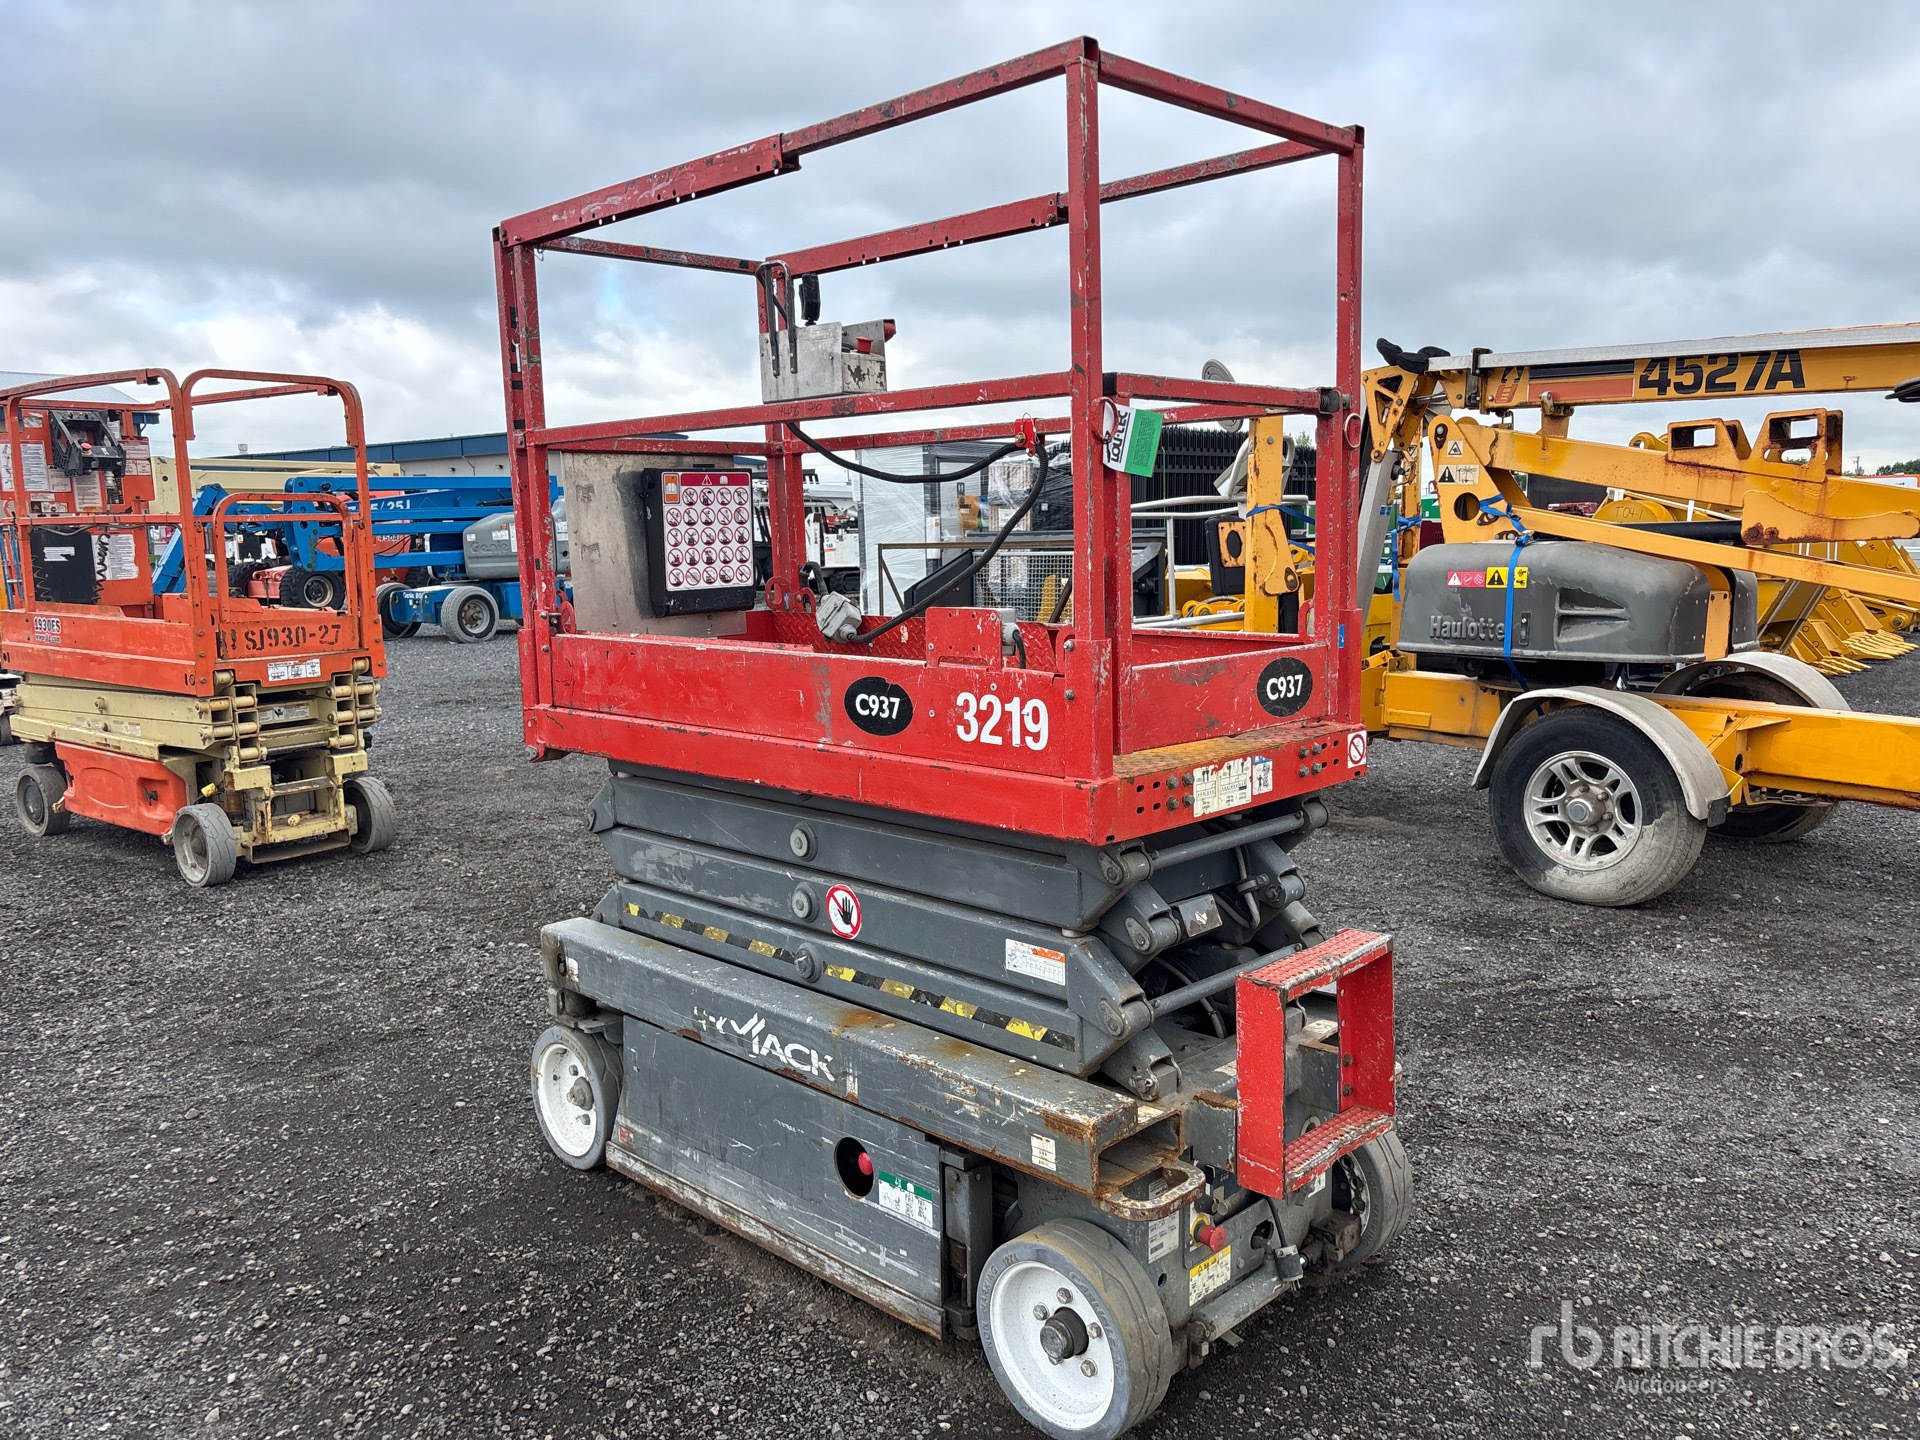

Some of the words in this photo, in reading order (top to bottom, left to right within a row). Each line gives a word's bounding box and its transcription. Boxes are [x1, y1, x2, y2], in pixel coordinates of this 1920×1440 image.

[1638, 351, 1806, 396] 4527A
[1429, 615, 1505, 641] Haulotte
[1266, 673, 1303, 700] C937
[855, 693, 900, 720] C937
[956, 692, 1049, 751] 3219
